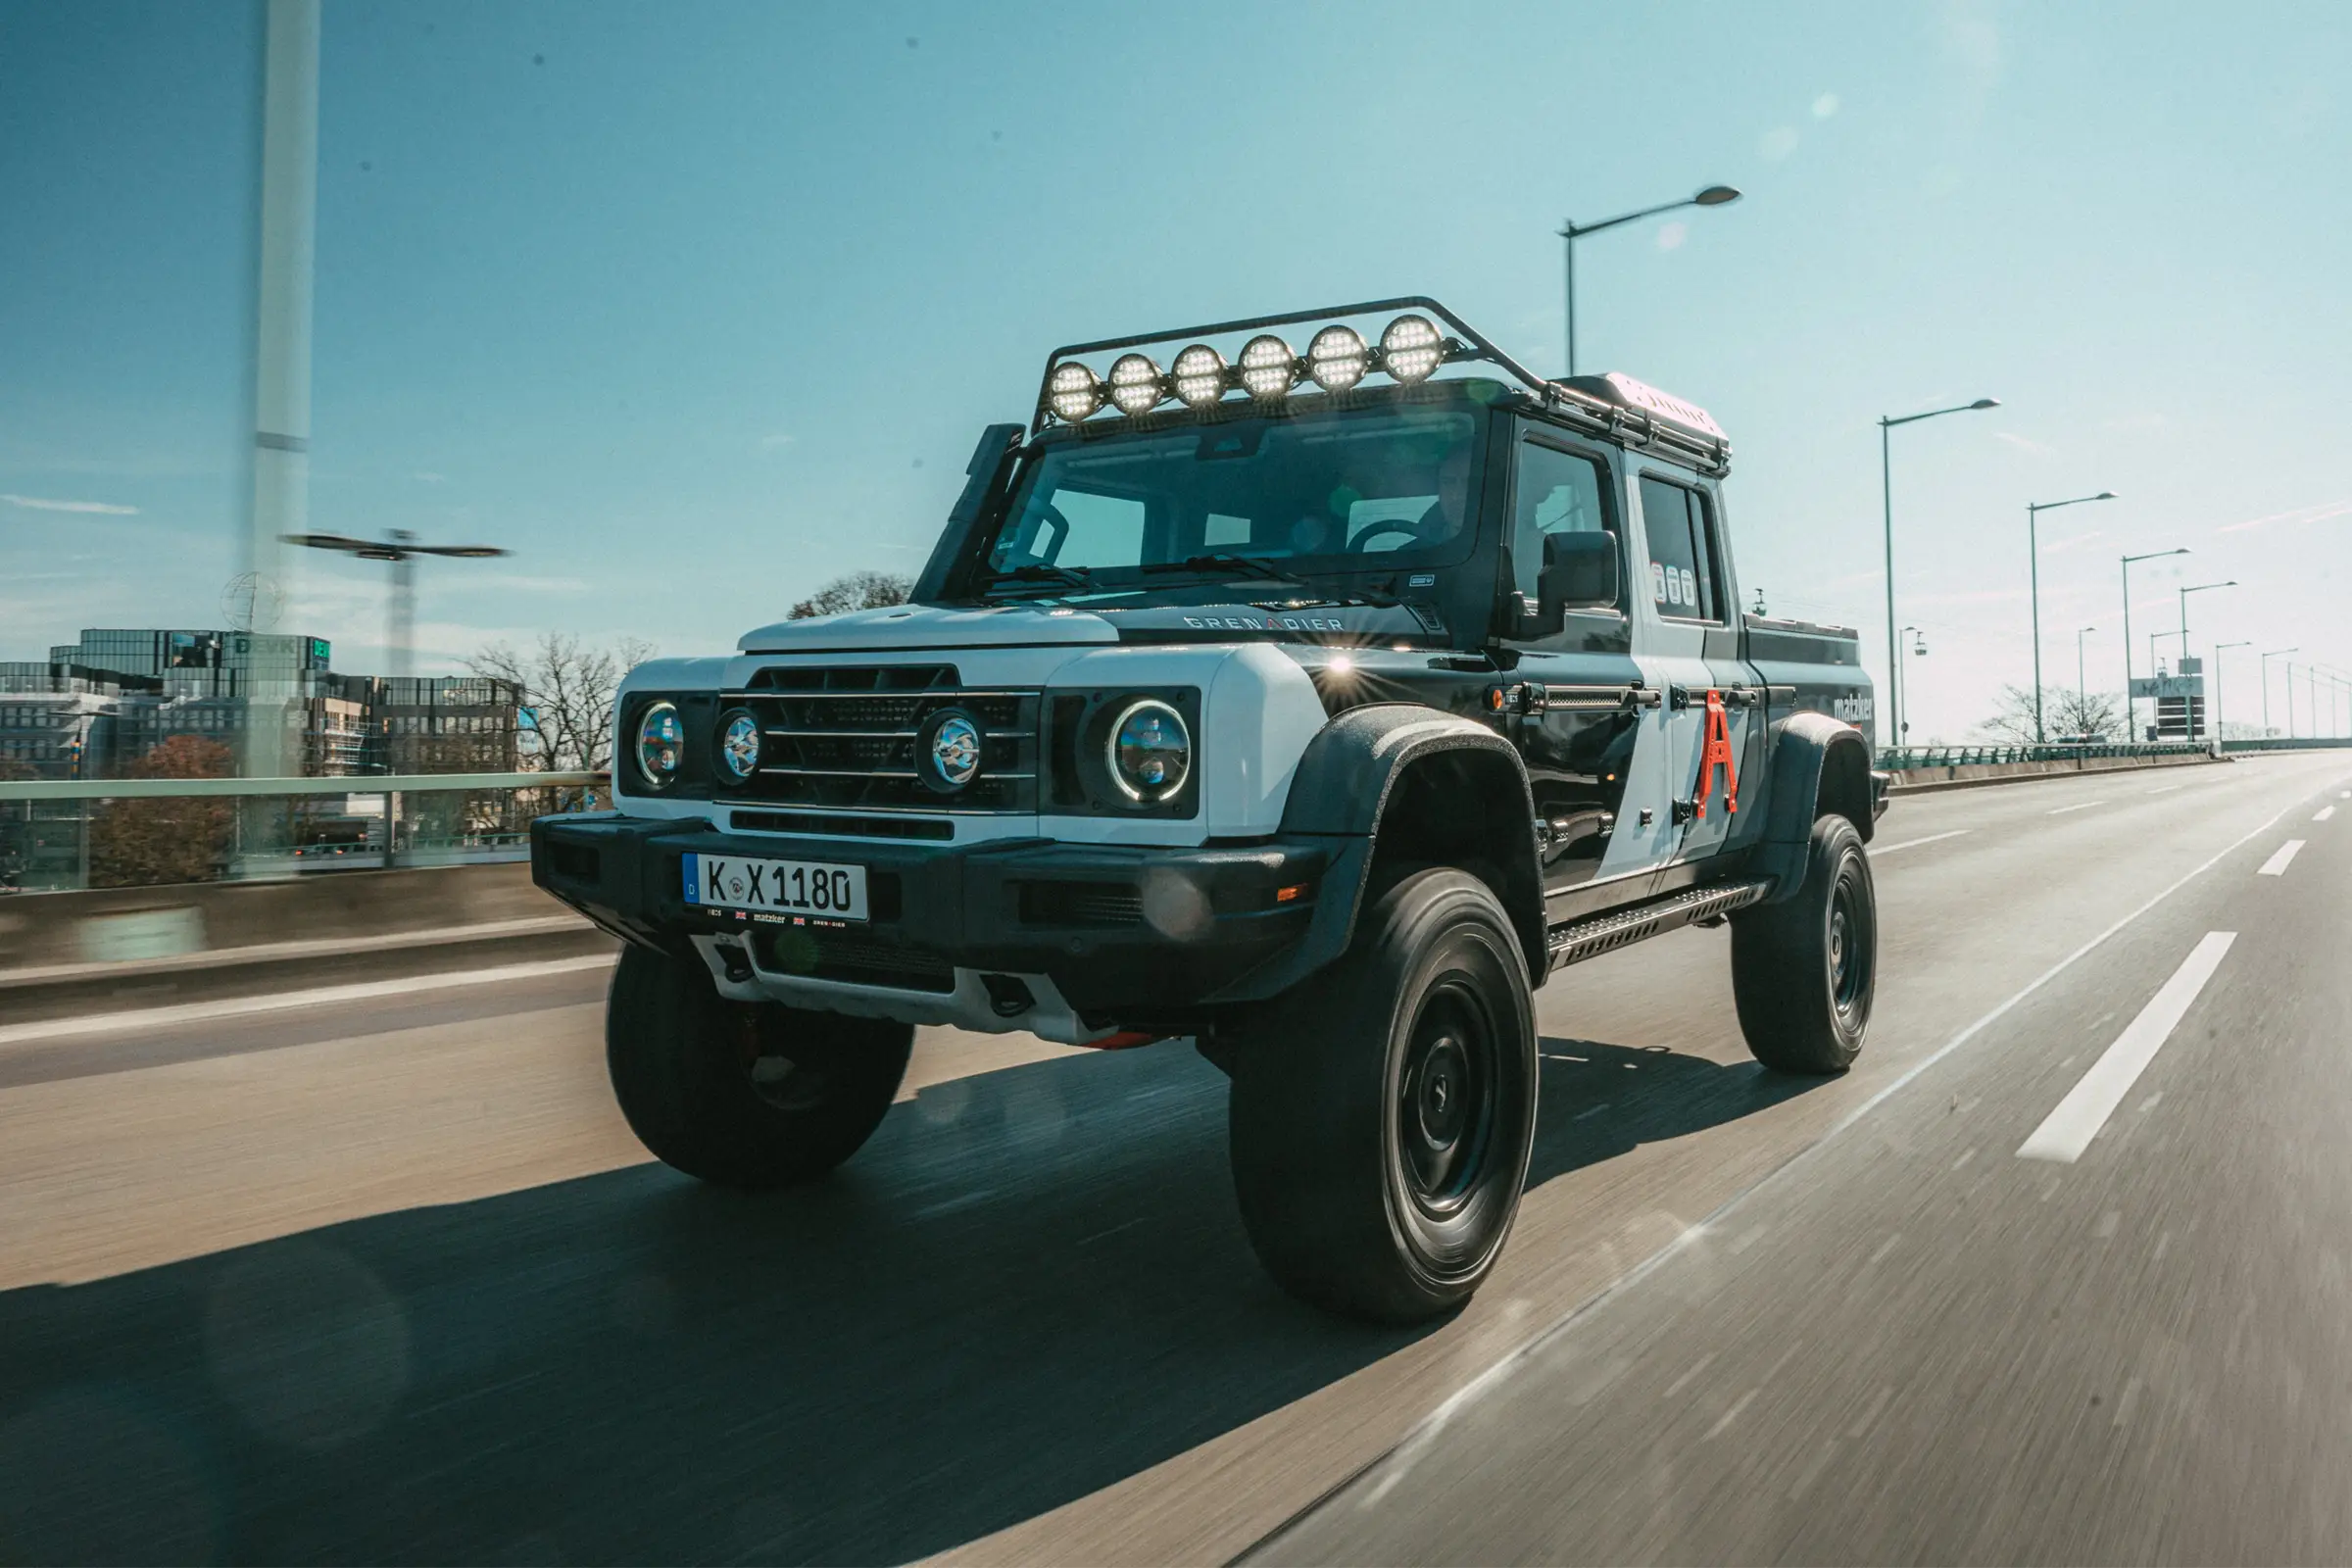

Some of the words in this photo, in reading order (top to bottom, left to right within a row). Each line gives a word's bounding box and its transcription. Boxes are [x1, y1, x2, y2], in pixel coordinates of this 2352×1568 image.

[1184, 616, 1346, 631] GRENADIER
[235, 638, 296, 655] DEVK
[1834, 693, 1873, 722] matzker
[688, 883, 696, 896] D
[753, 913, 786, 924] matzker
